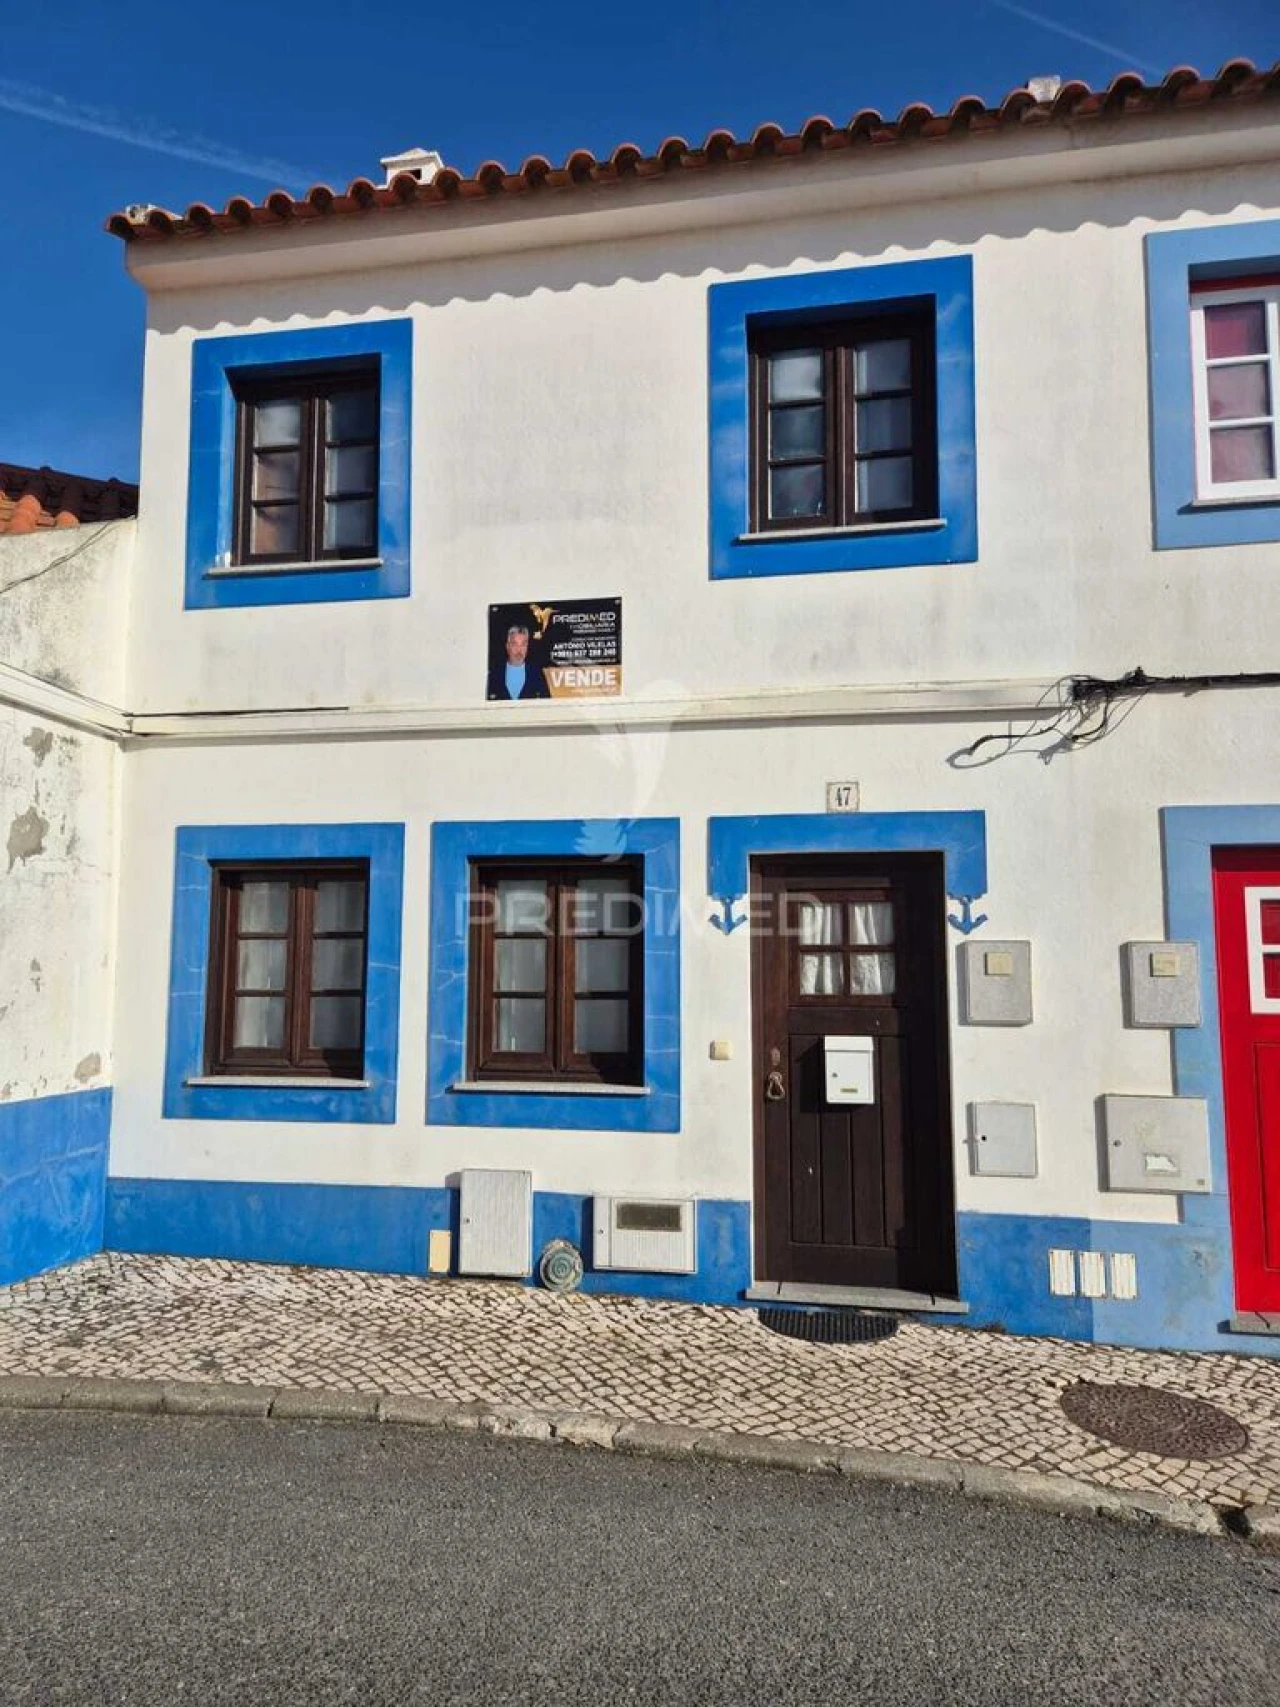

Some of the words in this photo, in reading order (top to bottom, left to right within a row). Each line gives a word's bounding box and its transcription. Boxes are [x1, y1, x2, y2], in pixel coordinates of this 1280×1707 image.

[553, 612, 616, 624] PREDIMED
[551, 669, 616, 687] VENDE
[835, 786, 851, 806] 47
